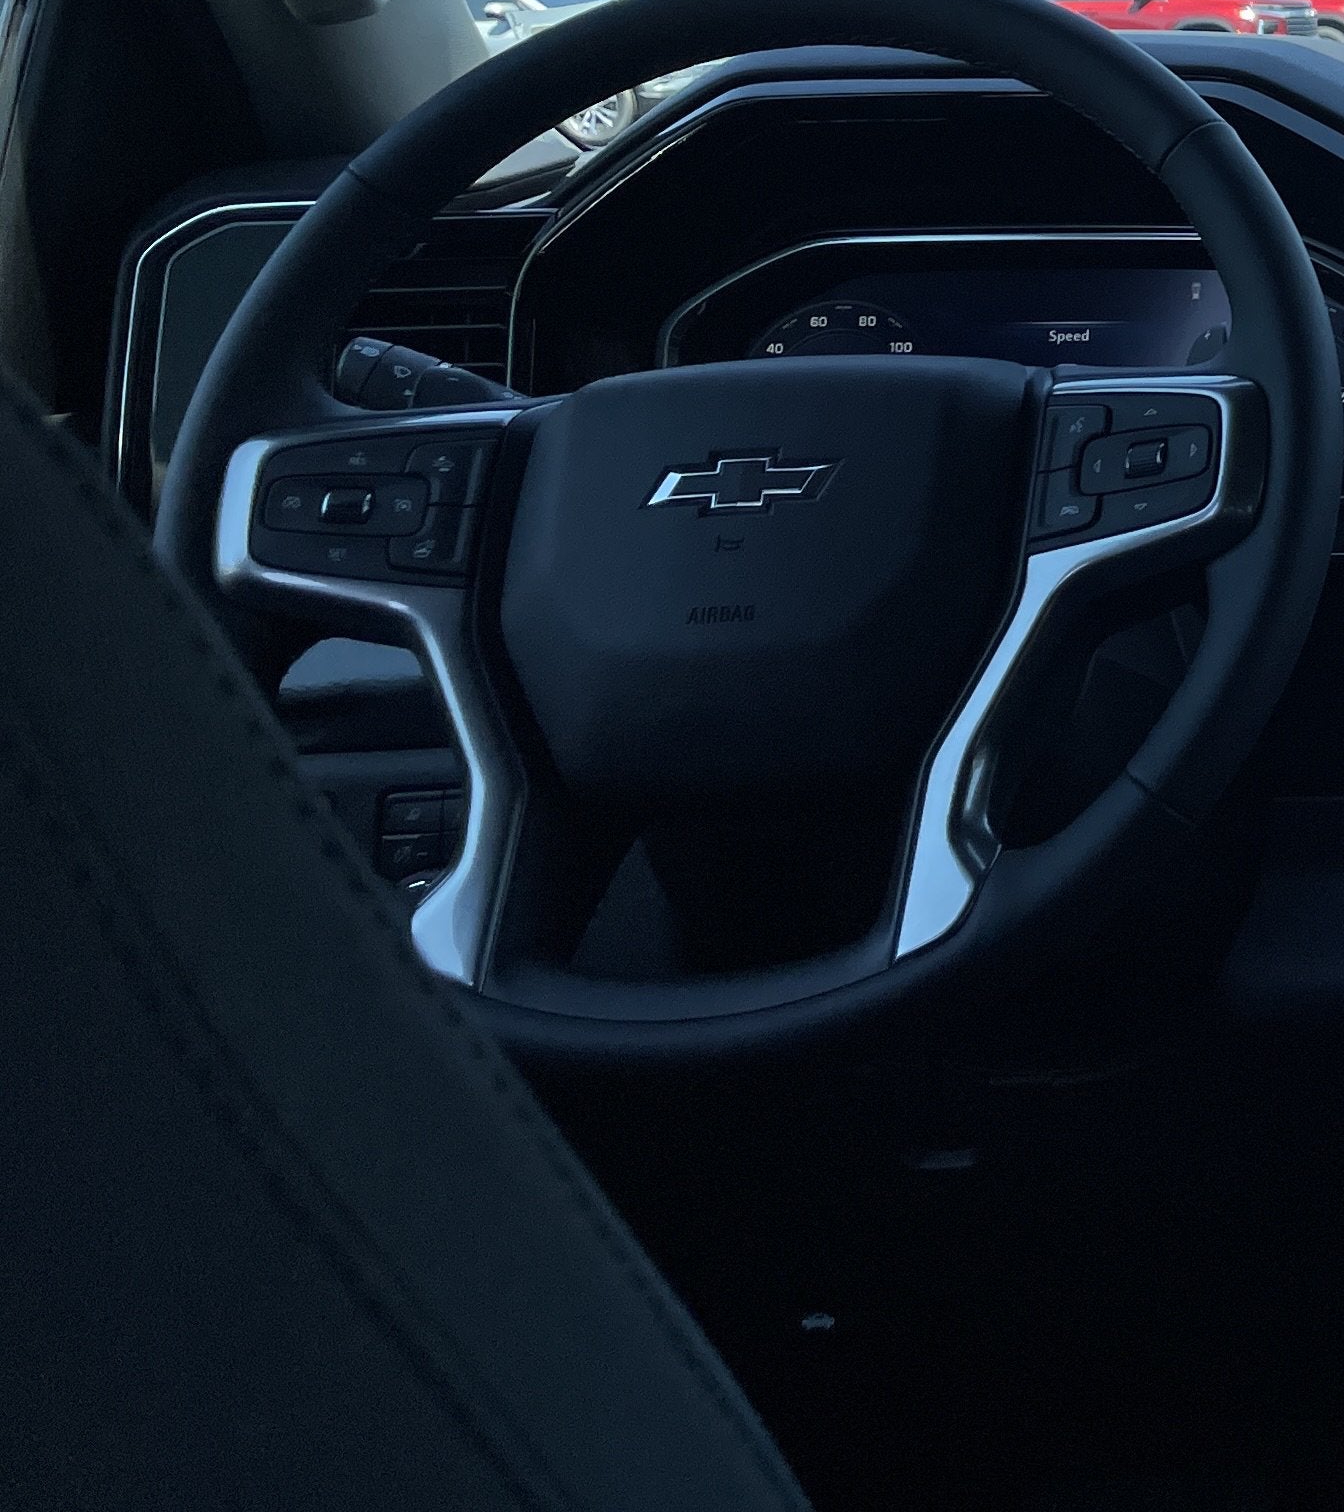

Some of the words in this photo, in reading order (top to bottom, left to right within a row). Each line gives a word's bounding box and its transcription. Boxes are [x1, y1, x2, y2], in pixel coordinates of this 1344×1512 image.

[809, 316, 828, 328] 60
[858, 316, 877, 328] 80
[1048, 329, 1090, 346] Speed
[766, 343, 784, 355] 40
[889, 342, 913, 354] 100
[685, 604, 755, 625] AIRBAG
